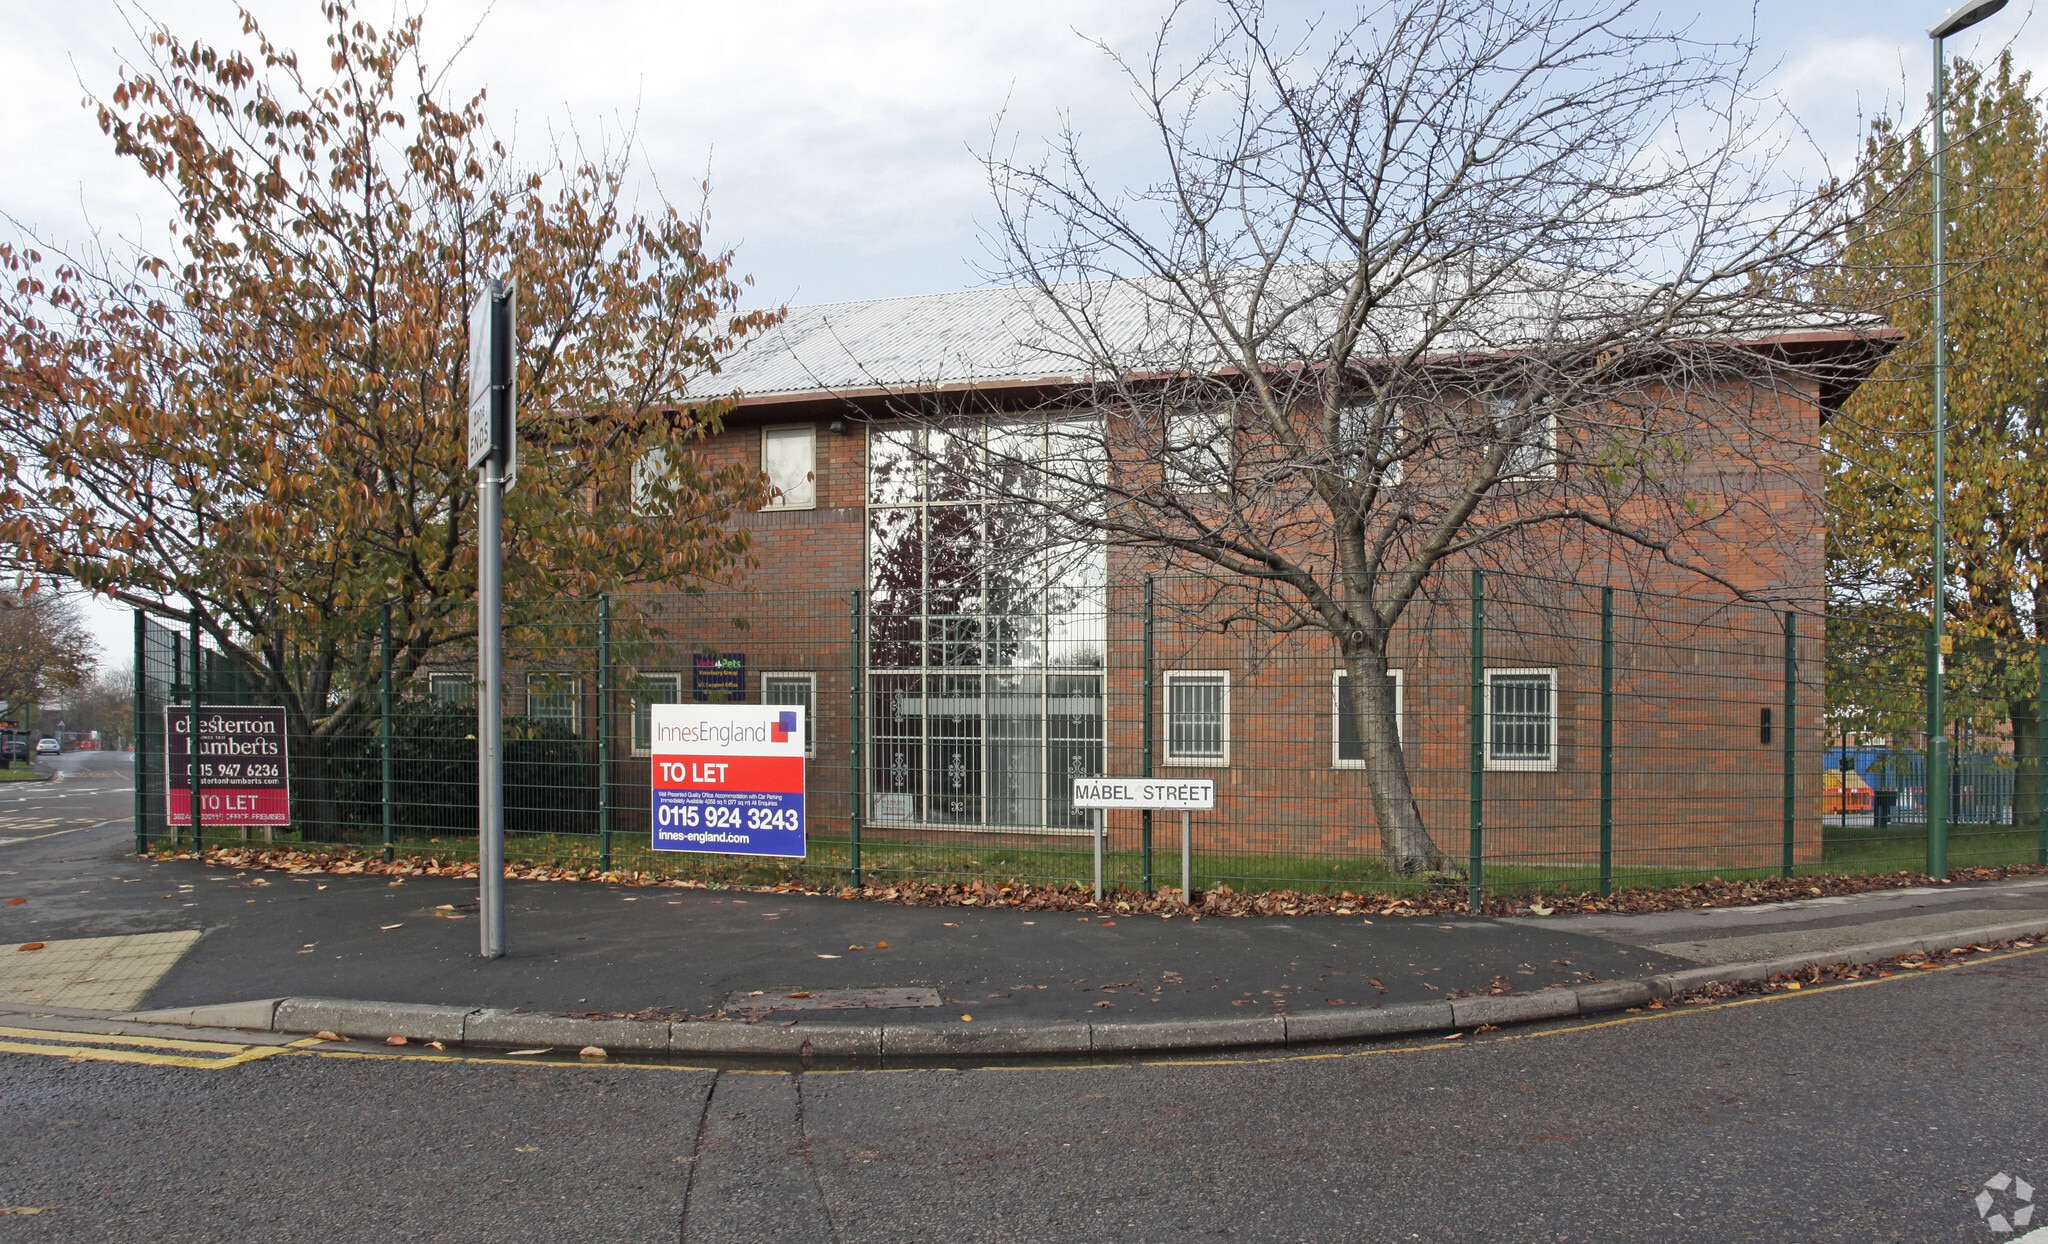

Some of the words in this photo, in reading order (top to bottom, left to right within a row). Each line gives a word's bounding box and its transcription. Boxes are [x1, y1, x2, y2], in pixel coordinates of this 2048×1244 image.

[473, 404, 485, 428] Zone
[470, 421, 489, 458] ENDS
[657, 720, 766, 747] InnesEngland
[218, 764, 241, 777] 947
[247, 764, 279, 777] 6236
[659, 762, 687, 783] TO
[692, 763, 729, 784] LET
[200, 795, 220, 810] TO
[226, 795, 259, 810] LET
[1075, 785, 1134, 800] MABEL
[1143, 785, 1211, 801] STREET
[658, 805, 700, 828] 0115
[705, 806, 742, 829] 924
[747, 808, 799, 831] 3243
[658, 828, 750, 844] innes-england.com
